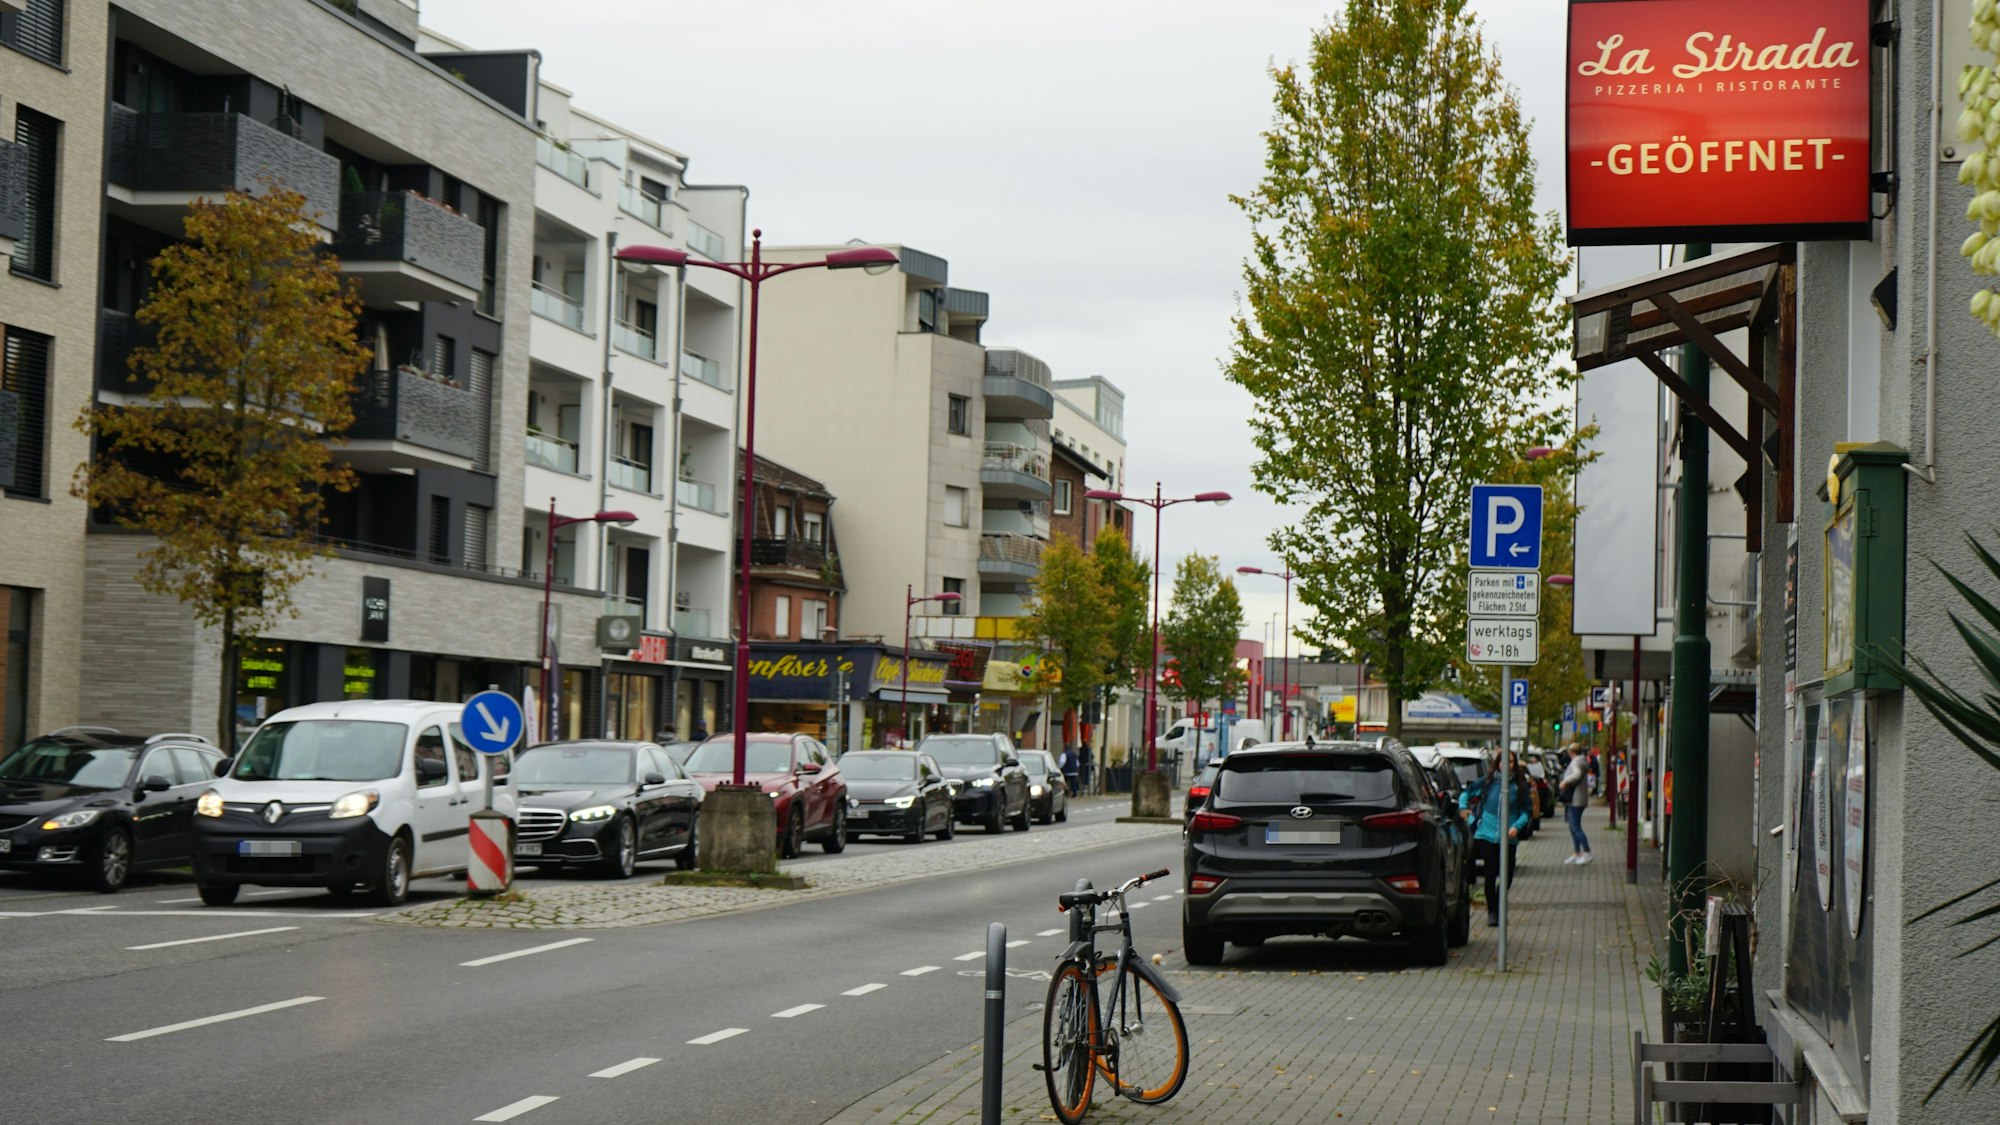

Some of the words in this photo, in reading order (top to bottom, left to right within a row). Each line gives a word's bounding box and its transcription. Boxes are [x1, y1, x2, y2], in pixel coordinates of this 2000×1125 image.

[1578, 33, 1655, 76] La
[1672, 27, 1859, 79] Strada
[1595, 82, 1685, 96] PIZZERIA
[1716, 78, 1842, 92] RISTORANTE
[1486, 496, 1525, 557] P
[1475, 577, 1500, 587] Parken
[1502, 577, 1514, 588] mit
[1526, 577, 1534, 588] in
[1472, 590, 1536, 601] gekennzeichneten
[1478, 601, 1506, 611] Flächen
[1474, 625, 1532, 641] werktags
[1486, 644, 1519, 657] 9-18h
[1513, 682, 1525, 704] P
